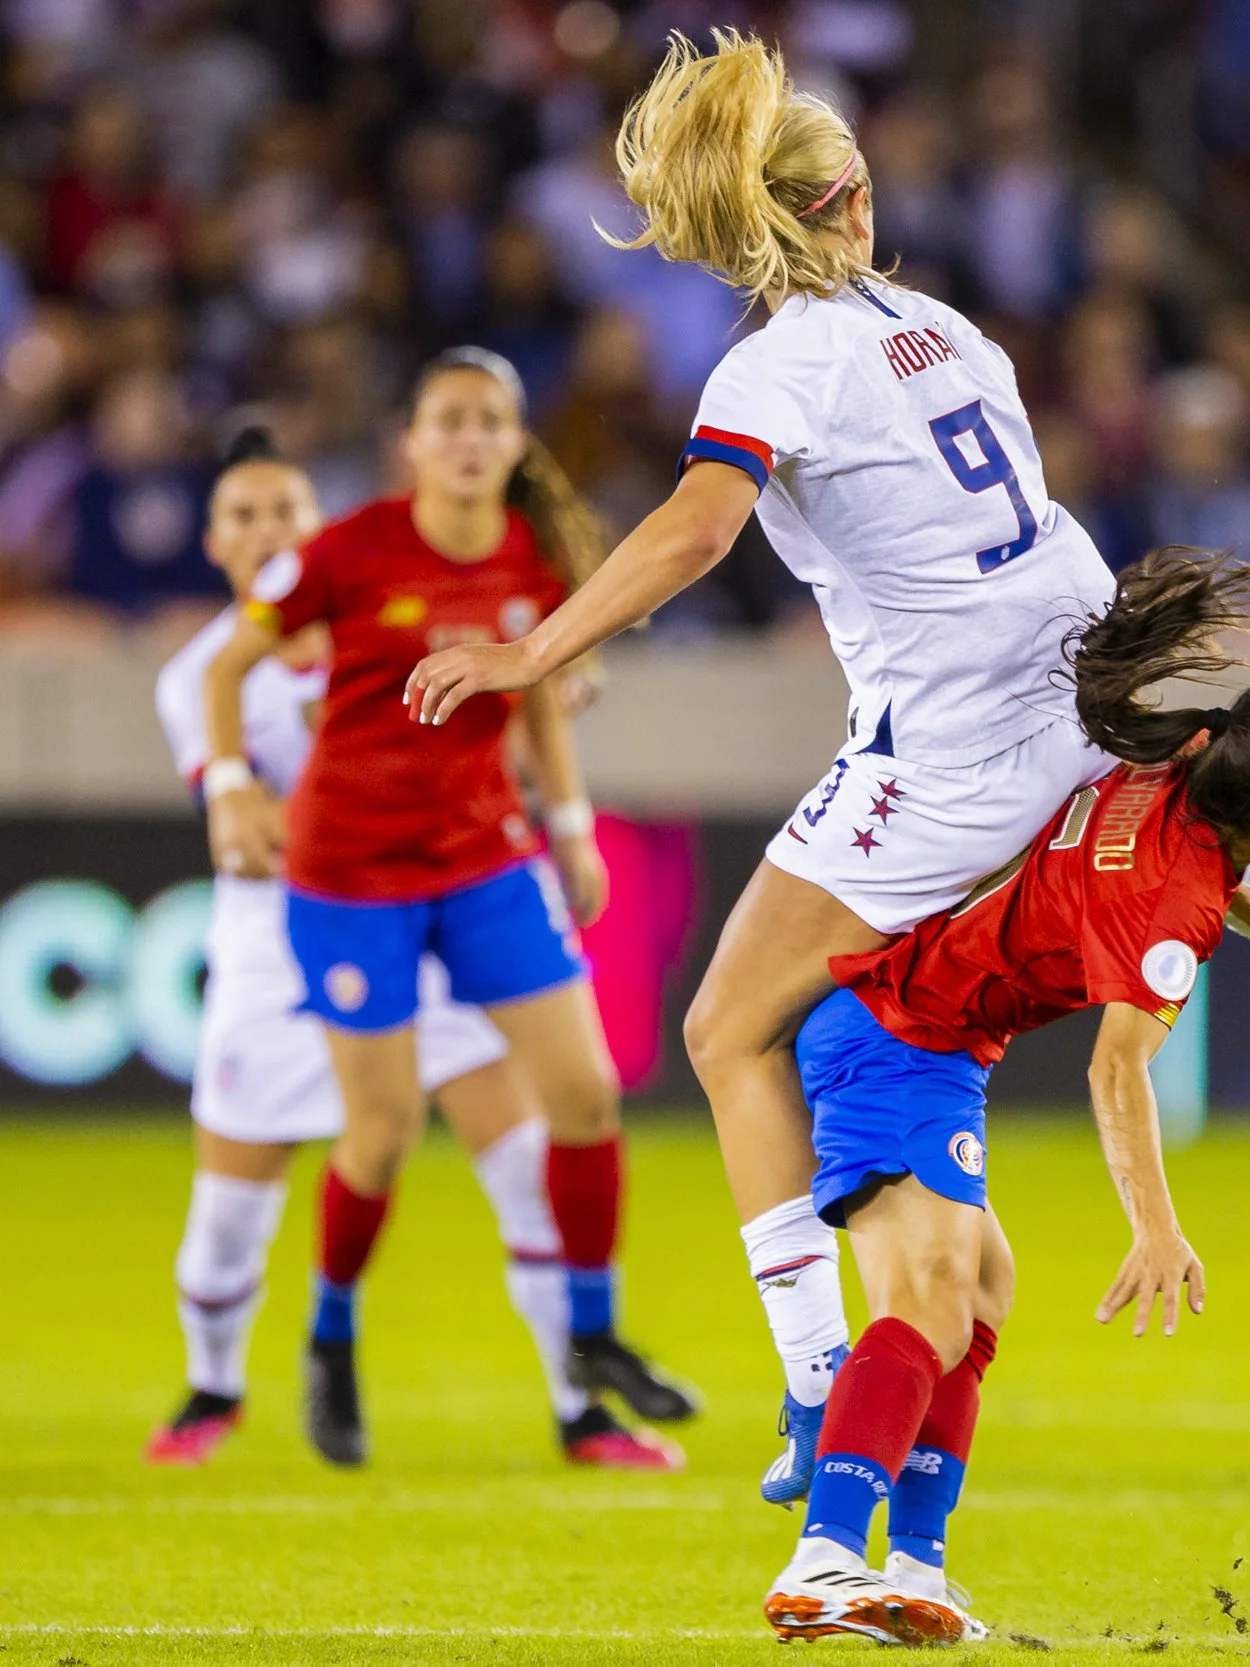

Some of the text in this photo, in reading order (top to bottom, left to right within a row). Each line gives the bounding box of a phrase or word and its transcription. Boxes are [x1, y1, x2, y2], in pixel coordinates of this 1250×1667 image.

[928, 399, 1038, 574] 9
[1094, 761, 1169, 872] LVARADO
[824, 1461, 876, 1483] COSTA
